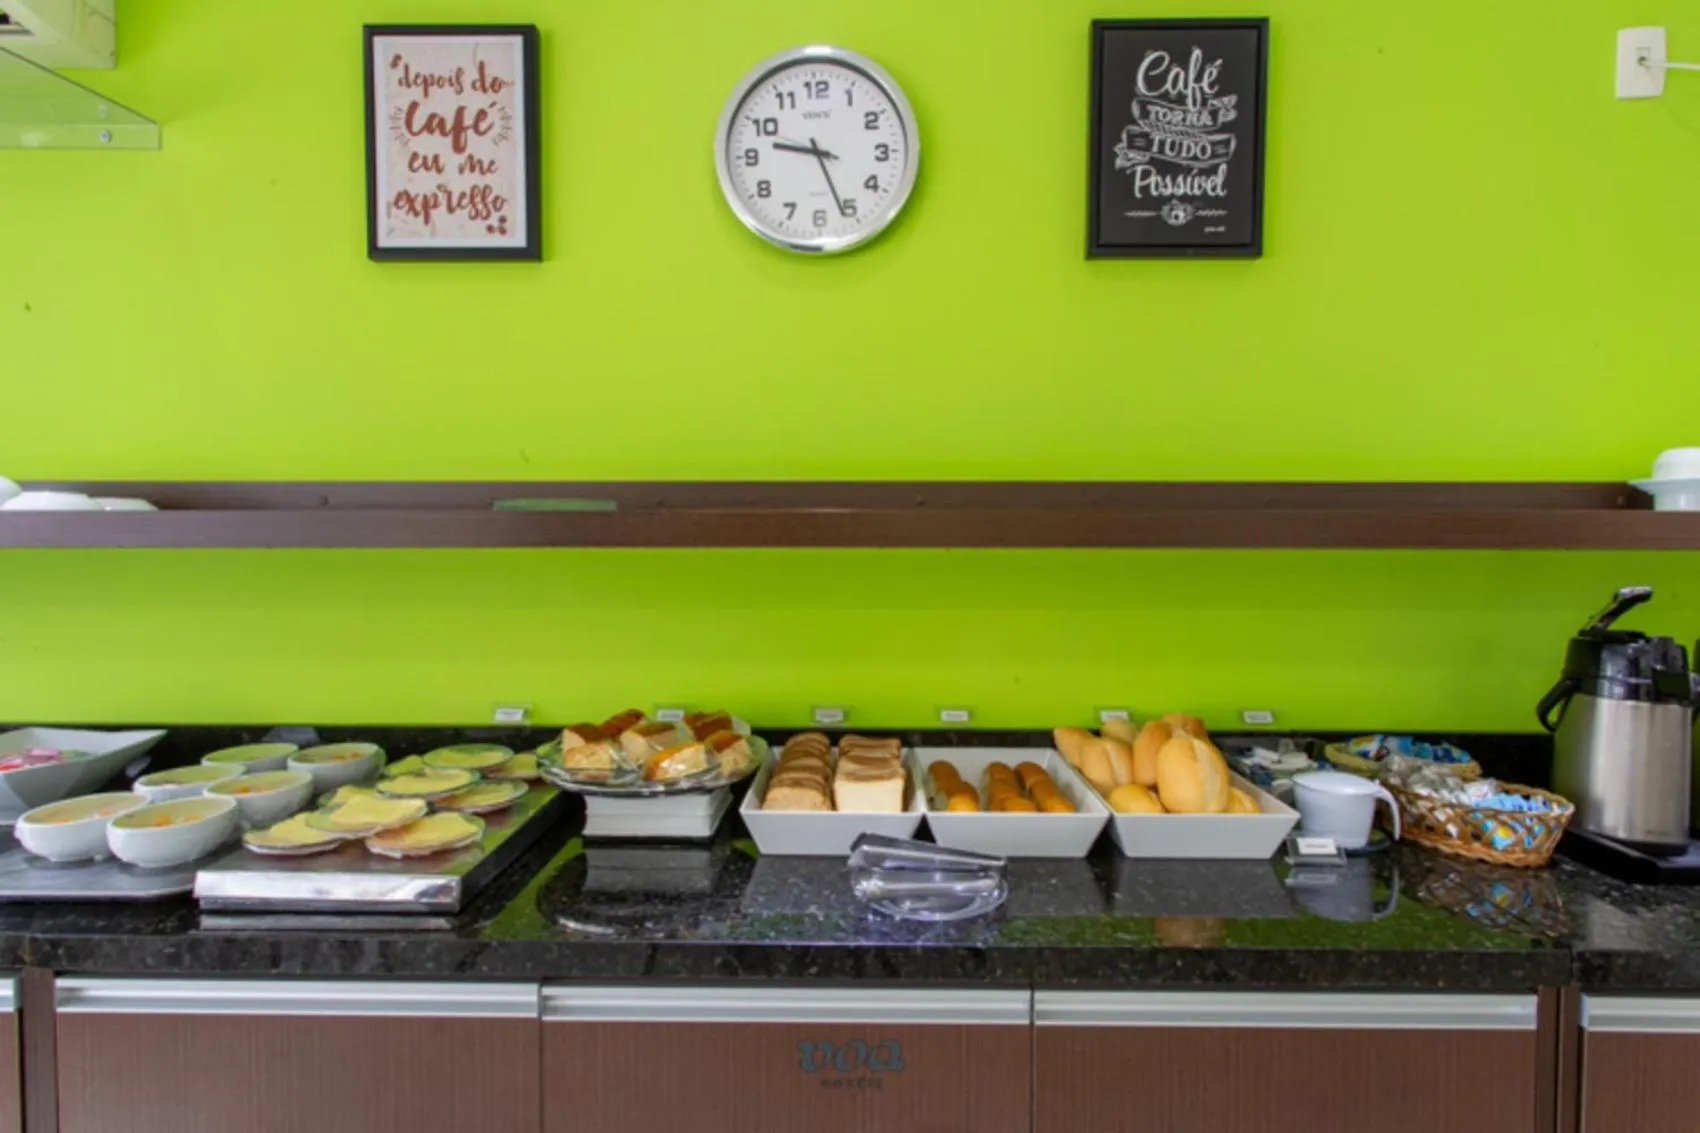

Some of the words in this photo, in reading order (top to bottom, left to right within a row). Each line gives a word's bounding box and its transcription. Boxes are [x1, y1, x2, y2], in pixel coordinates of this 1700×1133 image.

[398, 63, 465, 98] depois
[471, 60, 511, 94] do
[1135, 46, 1223, 112] Café
[803, 80, 830, 100] 12
[844, 88, 854, 107] 1
[775, 91, 797, 110] 11
[864, 111, 880, 130] 2
[1147, 104, 1214, 126] TORNA
[404, 100, 498, 154] Café
[752, 117, 779, 136] 10
[874, 143, 890, 162] 3
[1152, 135, 1212, 160] TUDO
[408, 151, 445, 174] eu
[458, 154, 498, 175] me
[744, 148, 760, 167] 9
[756, 180, 772, 198] 8
[863, 174, 880, 193] 4
[1127, 163, 1228, 199] Possível
[393, 184, 508, 226] expresso
[783, 202, 797, 221] 7
[843, 199, 858, 218] 5
[813, 209, 828, 228] 6
